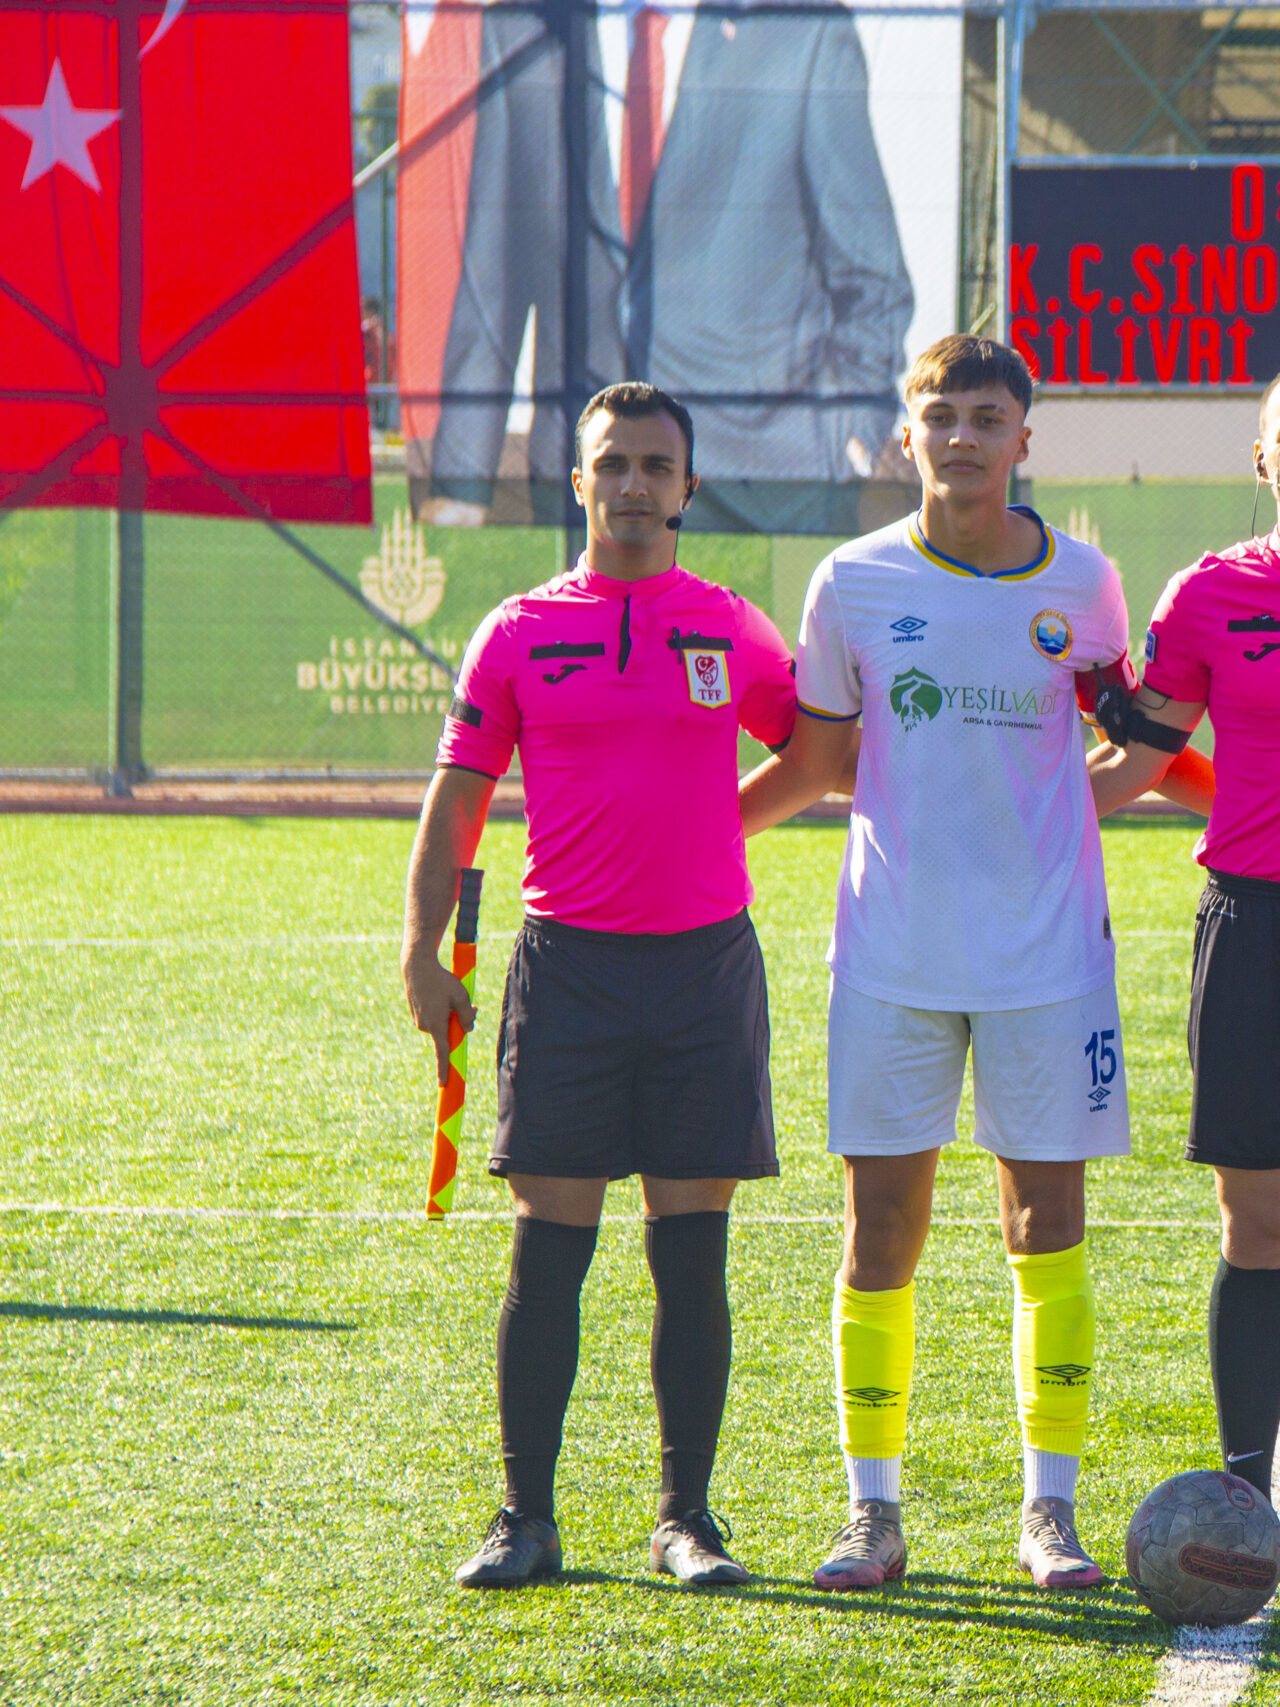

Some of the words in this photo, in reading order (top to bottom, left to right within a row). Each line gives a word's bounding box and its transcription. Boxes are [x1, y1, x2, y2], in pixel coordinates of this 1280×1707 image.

[330, 635, 468, 657] İSTANU
[892, 634, 924, 643] umbro
[297, 658, 459, 692] BÜYÜKŞE
[330, 693, 450, 714] BELEDİYE
[698, 689, 722, 701] TFF
[1084, 1029, 1117, 1087] 15
